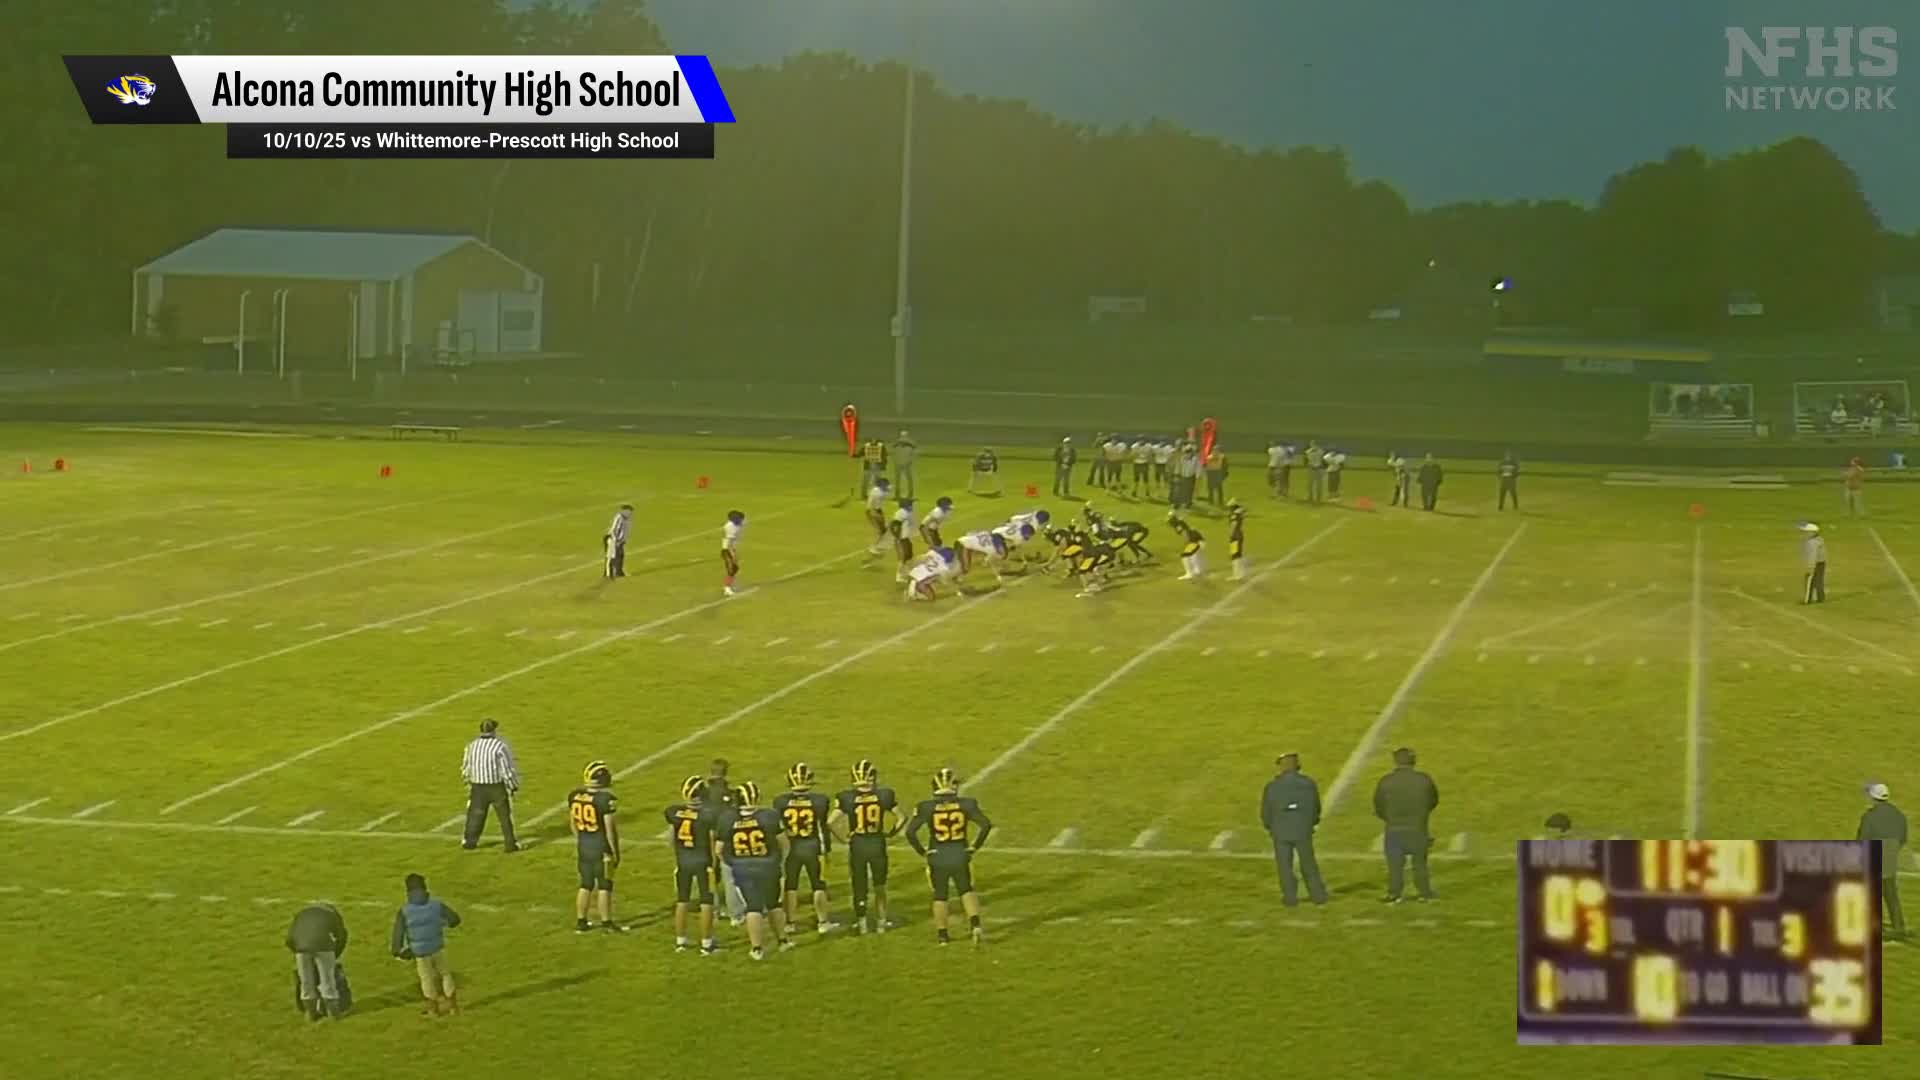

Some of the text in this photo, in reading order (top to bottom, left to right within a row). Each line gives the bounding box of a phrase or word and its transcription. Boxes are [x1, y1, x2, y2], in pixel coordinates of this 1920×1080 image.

[677, 819, 694, 847] 4
[783, 808, 814, 837] 33
[854, 804, 881, 834] 19
[933, 811, 965, 841] 52
[733, 830, 768, 857] 66
[1718, 904, 1735, 956] 1
[1835, 882, 1868, 945] 0
[1780, 913, 1807, 957] 3
[1536, 960, 1556, 1012] 1
[1808, 958, 1869, 1027] 35
